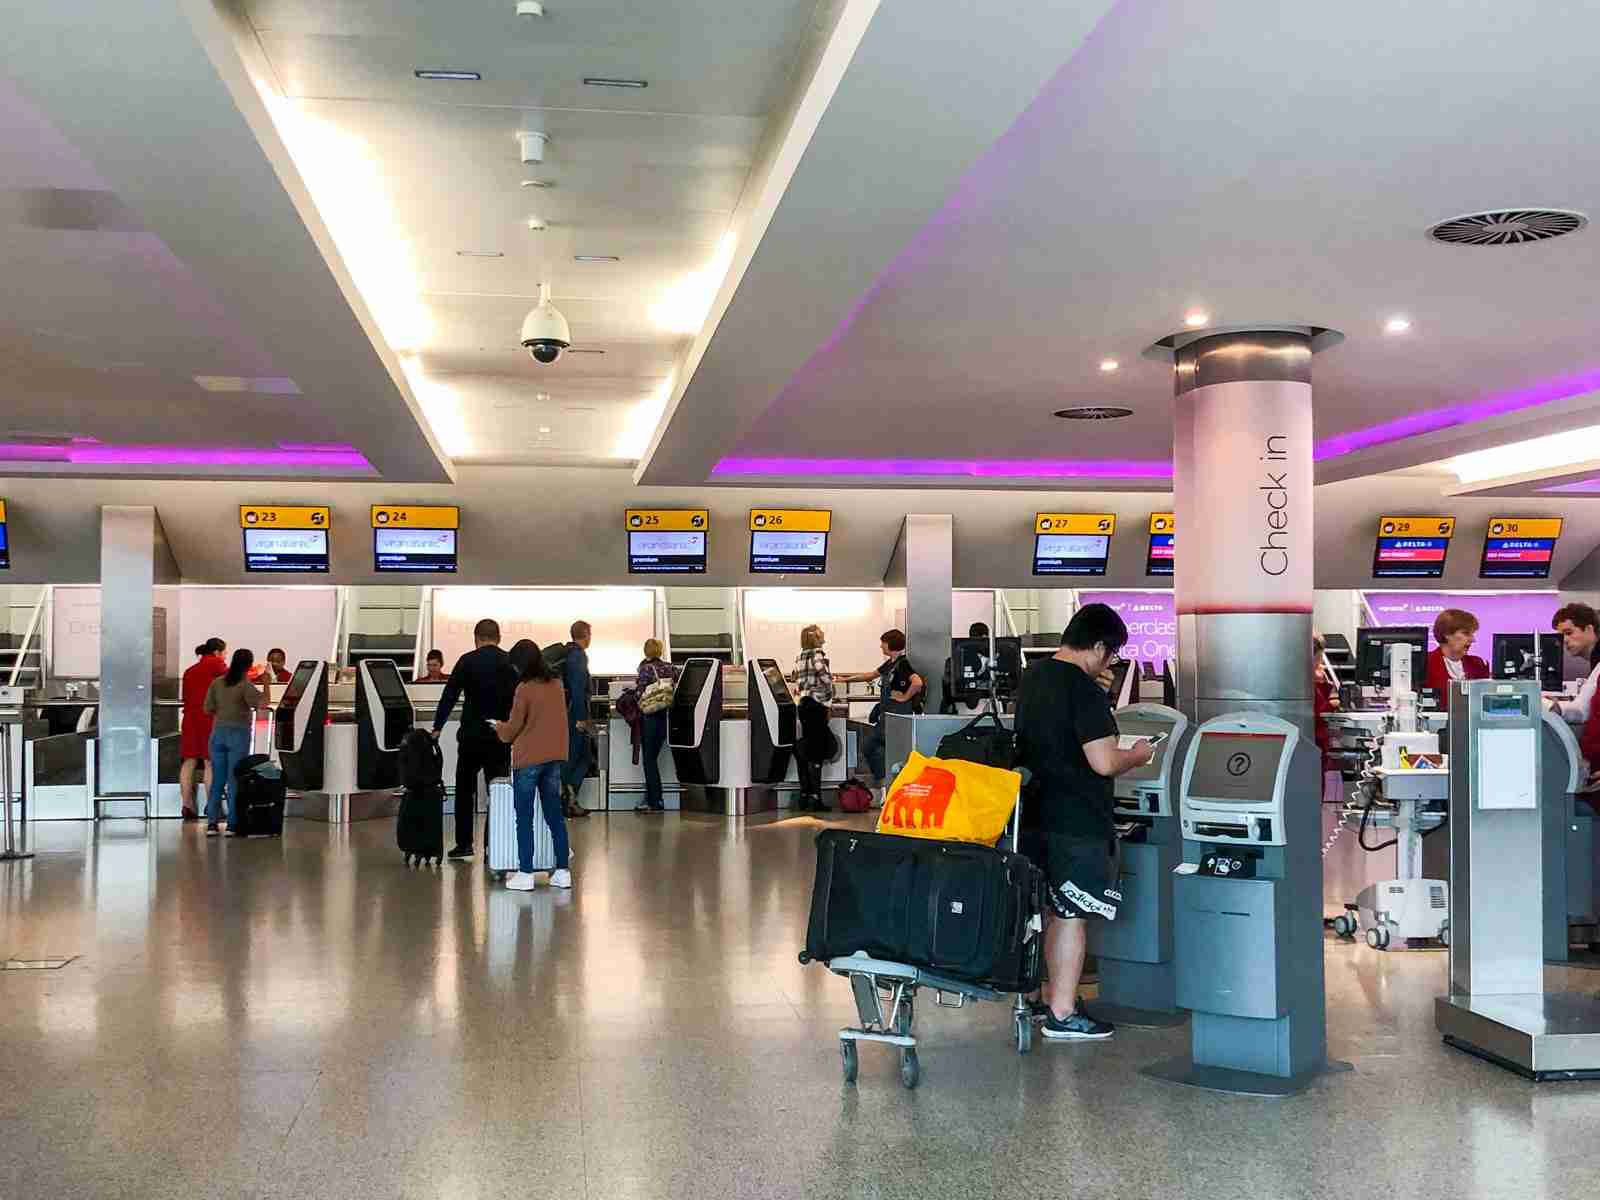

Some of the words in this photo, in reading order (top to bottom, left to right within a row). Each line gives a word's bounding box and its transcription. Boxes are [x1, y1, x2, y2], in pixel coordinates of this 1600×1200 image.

[1259, 435, 1288, 460] in
[262, 511, 277, 522] 23
[392, 511, 408, 522] 24
[645, 515, 660, 525] 25
[768, 515, 783, 525] 26
[1055, 519, 1069, 528] 27
[1259, 472, 1288, 576] Check
[1396, 522, 1410, 532] 29
[1505, 523, 1519, 533] 30
